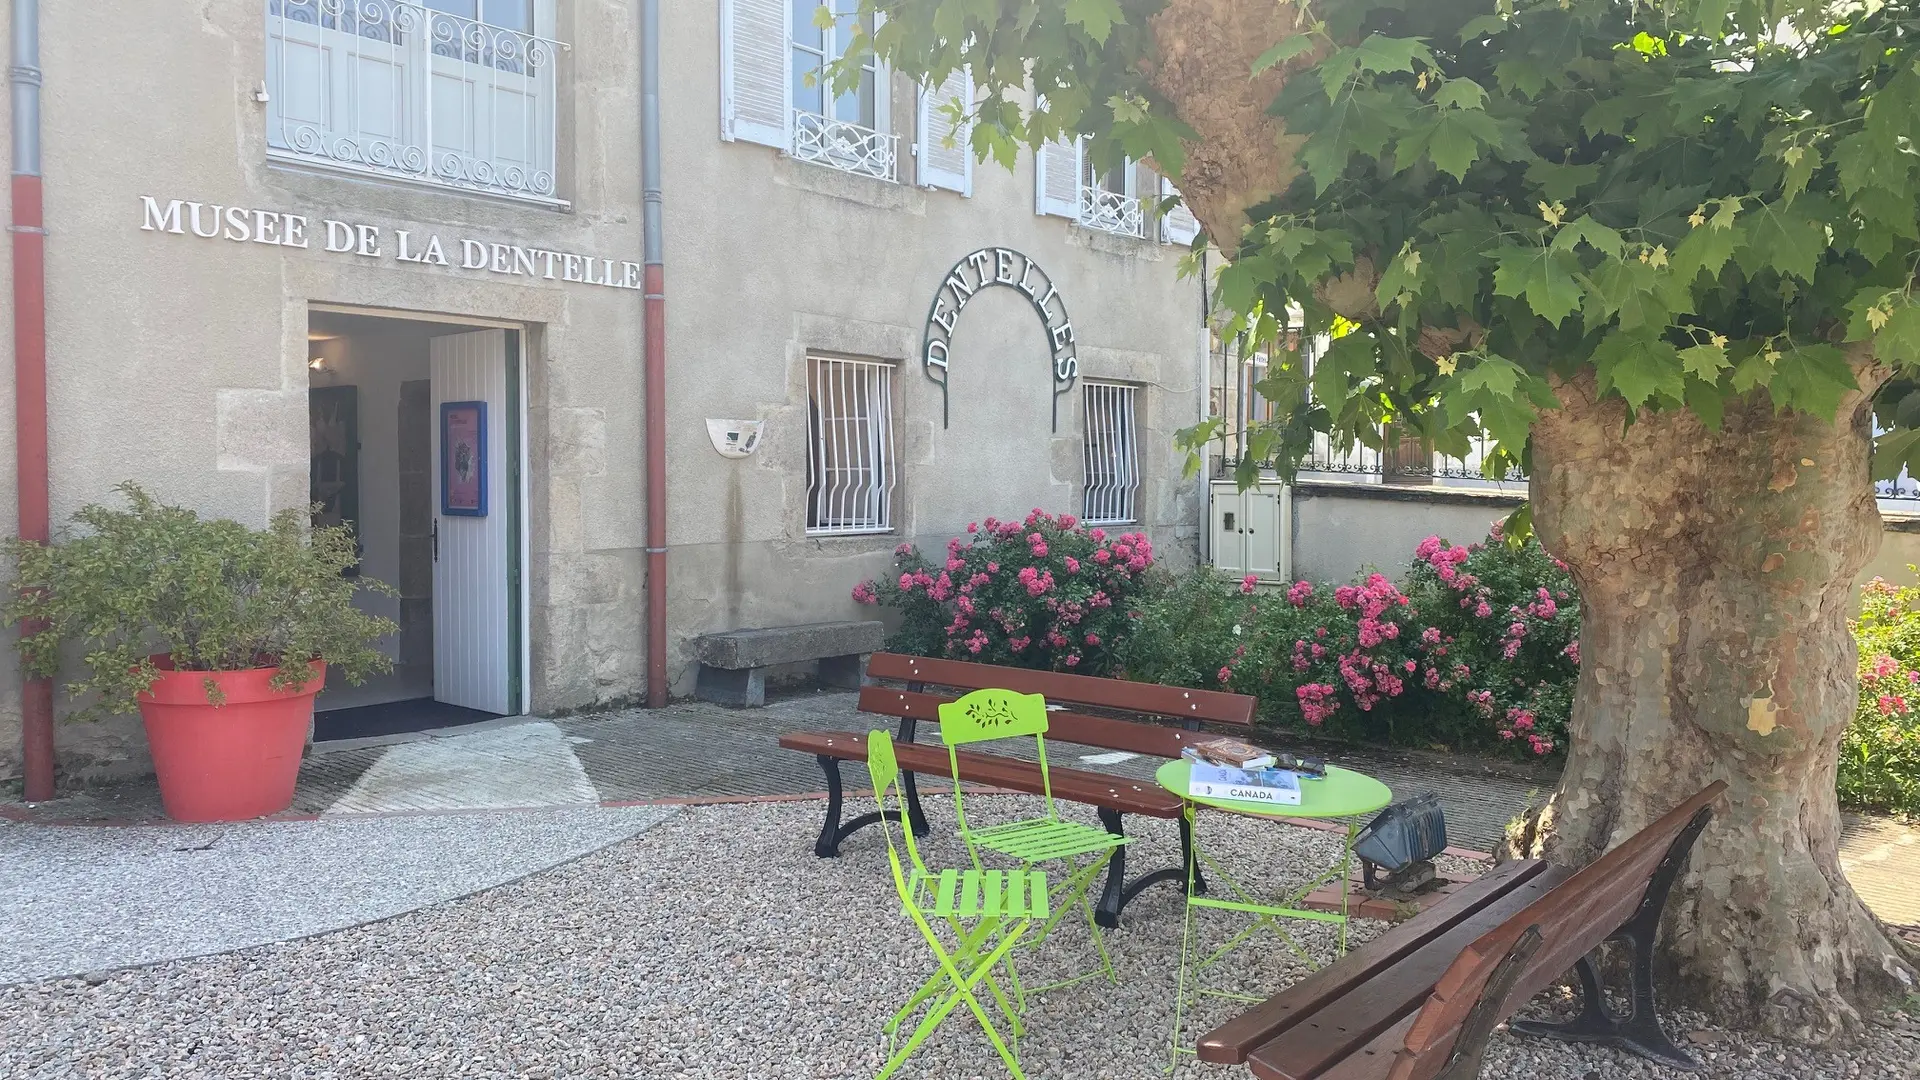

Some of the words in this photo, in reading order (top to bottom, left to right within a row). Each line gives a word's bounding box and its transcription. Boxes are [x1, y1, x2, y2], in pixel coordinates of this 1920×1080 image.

[140, 196, 308, 249] MUSEE
[324, 219, 381, 258] DE
[395, 230, 449, 266] LA
[460, 239, 641, 290] DENTELLE
[927, 248, 1079, 381] DENTELLES
[1230, 789, 1273, 800] CANADA
